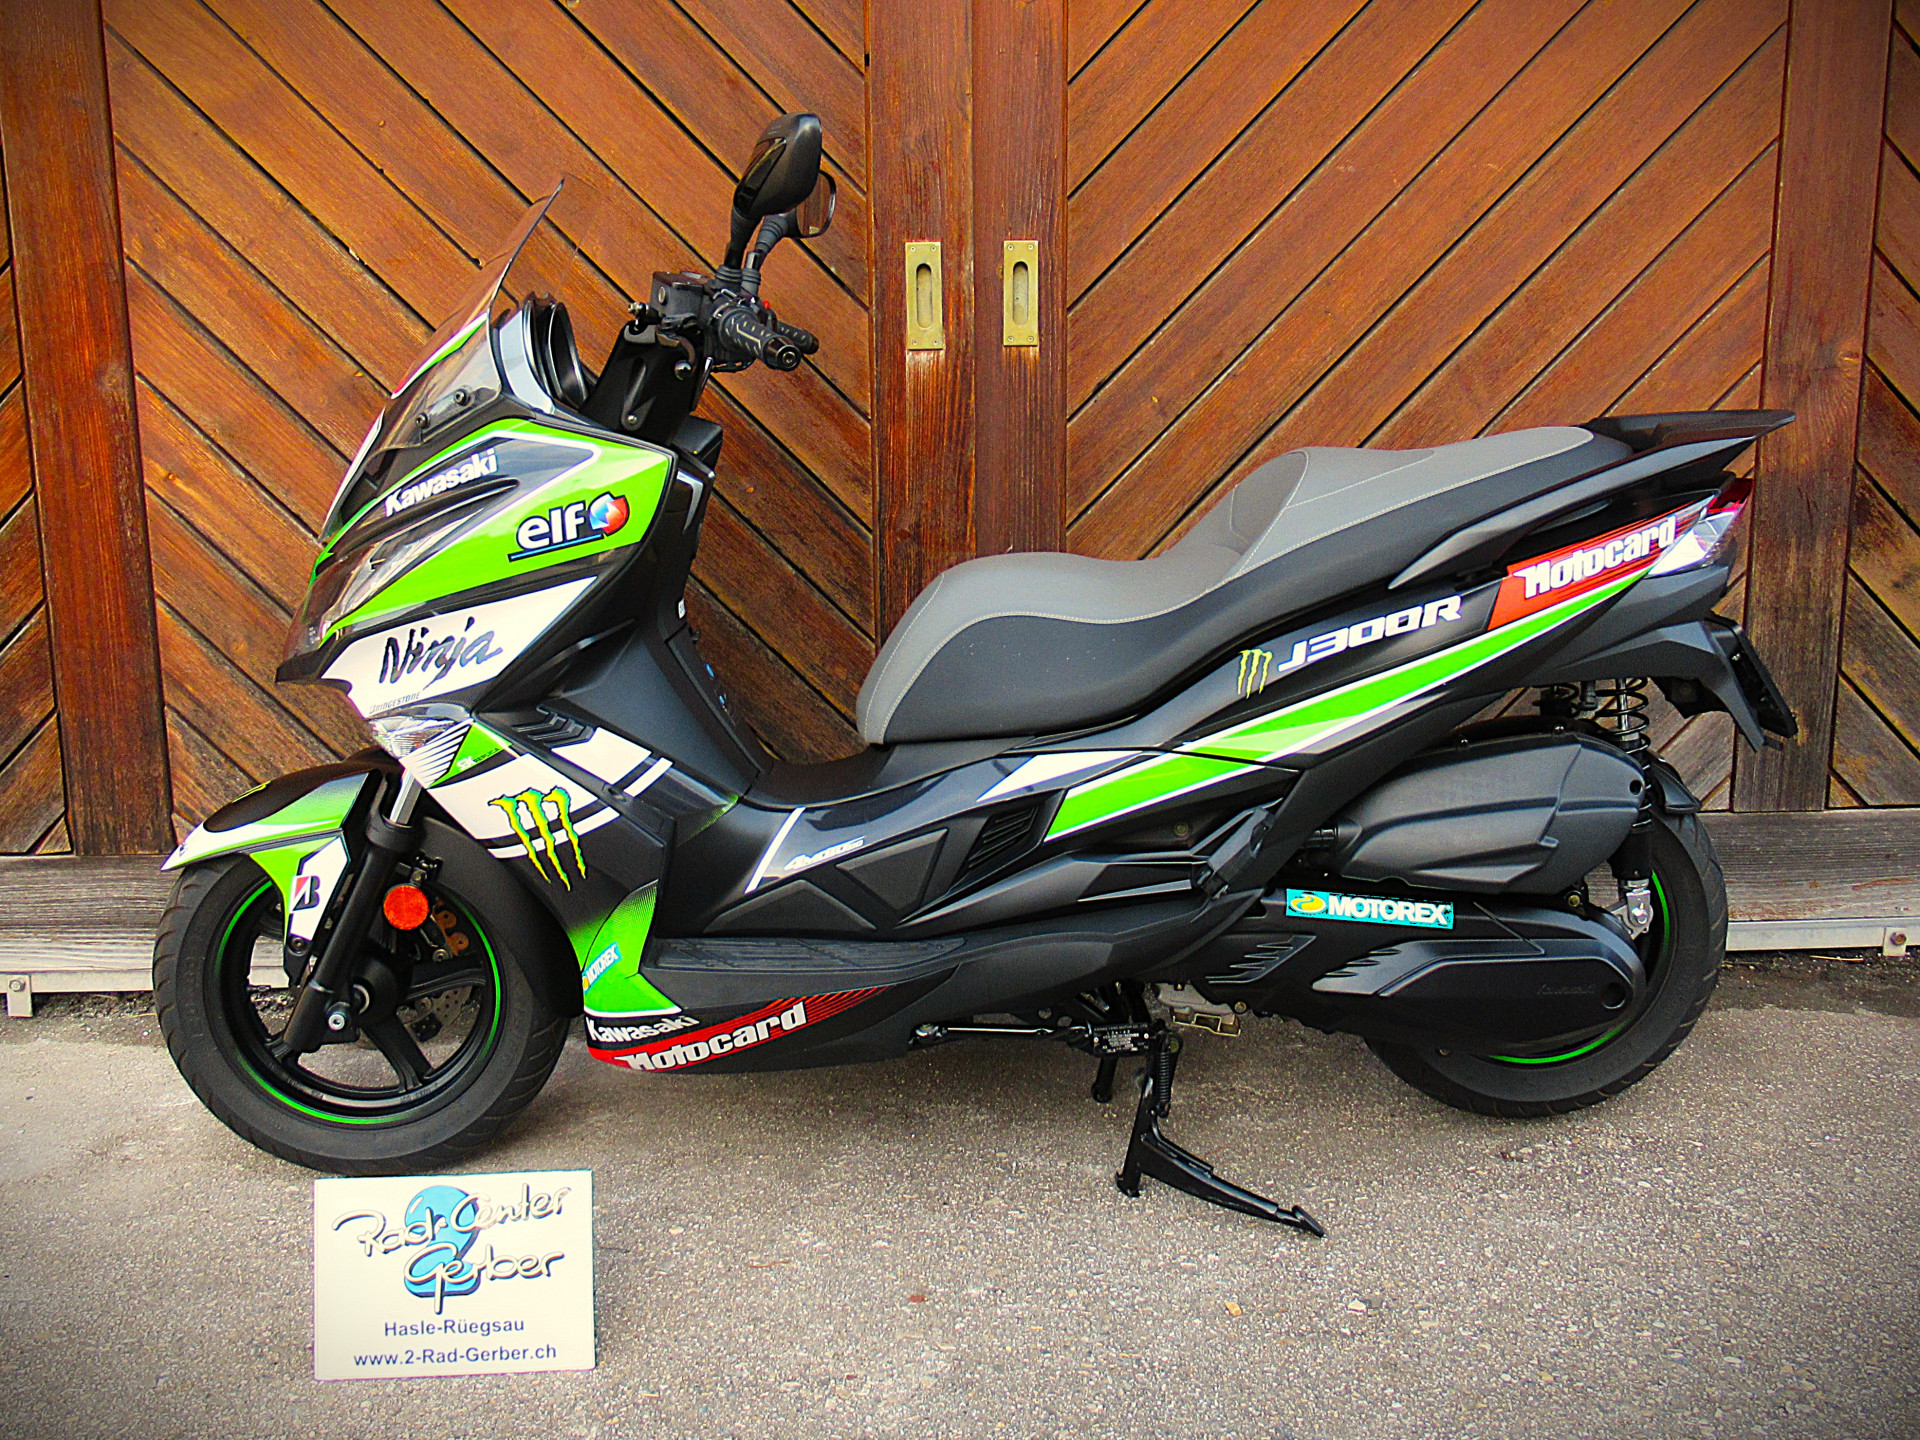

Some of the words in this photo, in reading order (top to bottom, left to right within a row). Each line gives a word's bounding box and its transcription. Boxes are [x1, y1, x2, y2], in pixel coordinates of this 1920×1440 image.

[384, 448, 498, 517] Kawasaki
[516, 500, 586, 551] elf
[1512, 514, 1678, 600] Motocard
[379, 616, 503, 690] Ninja
[1277, 594, 1463, 673] J300R
[1328, 895, 1449, 925] MOTOREX
[585, 943, 620, 985] MOTOREX
[585, 1015, 700, 1043] Kawasaki
[614, 1001, 808, 1071] Motocard
[403, 1242, 566, 1315] Gerber
[353, 1344, 557, 1367] www.2-Rad-Gerber.ch
[383, 1318, 525, 1337] Hasle-Rüegsau
